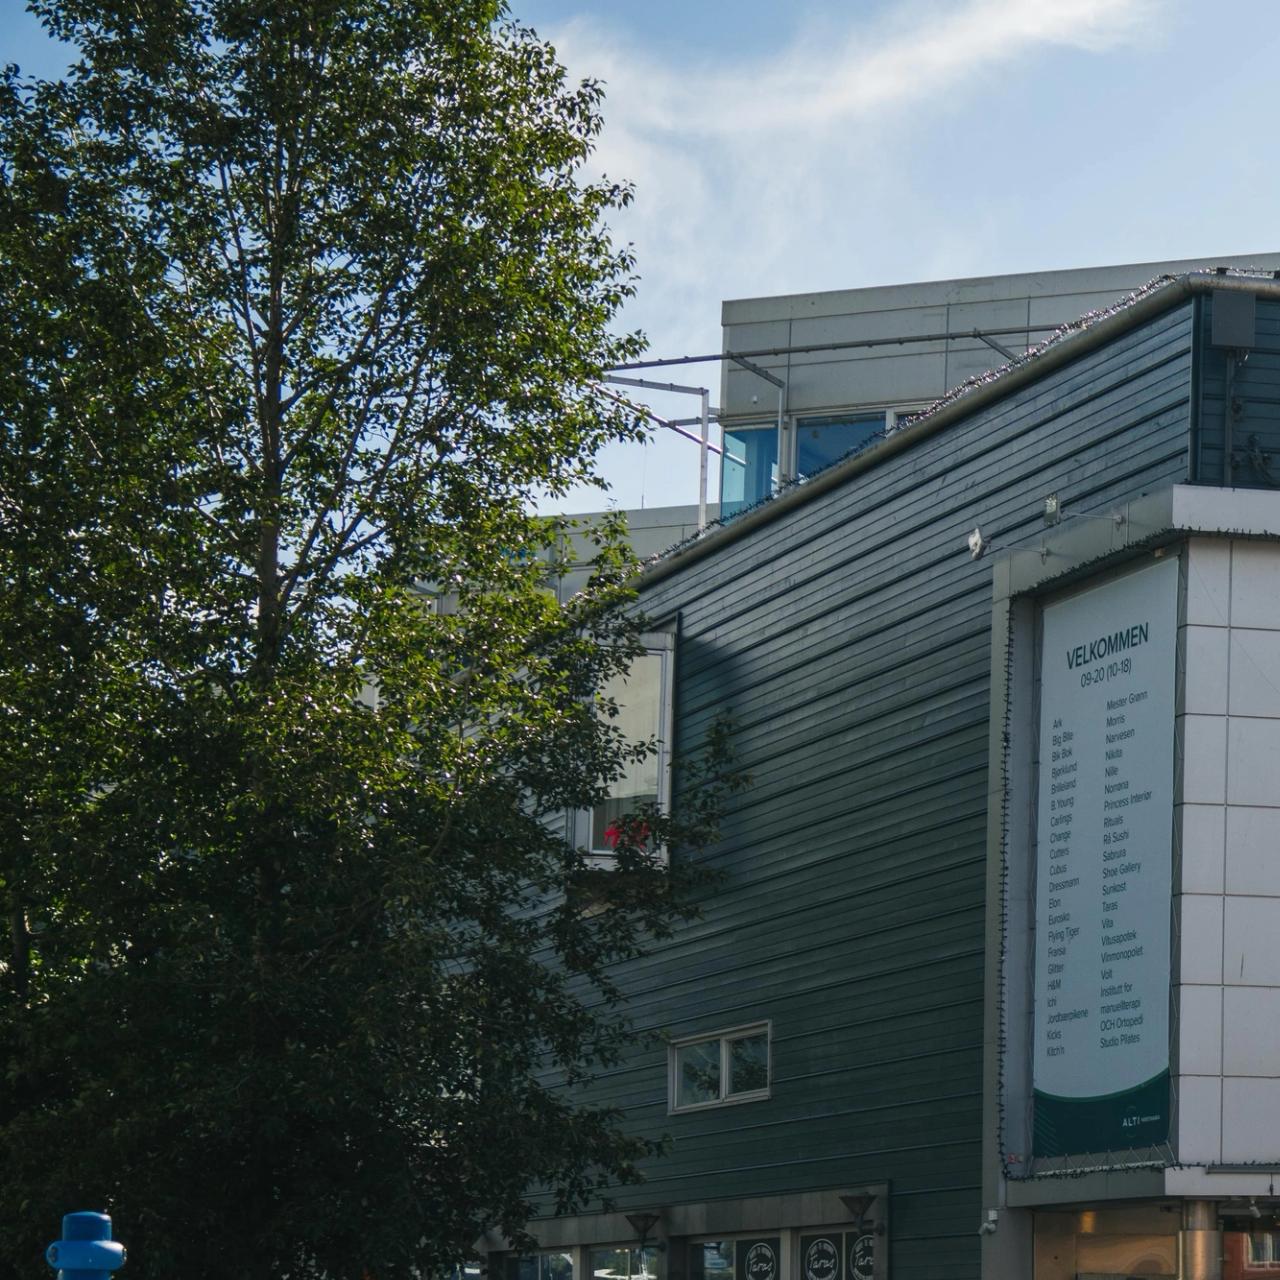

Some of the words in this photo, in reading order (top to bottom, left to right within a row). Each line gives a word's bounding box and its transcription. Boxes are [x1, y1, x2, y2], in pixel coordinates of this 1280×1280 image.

[1066, 622, 1149, 670] VELKOMMEN
[1080, 666, 1105, 688] 09-20
[1107, 658, 1132, 682] (10-18)
[1105, 728, 1135, 744] Narvesen
[1104, 797, 1129, 811] Princess
[1050, 813, 1073, 828] Carlings
[1103, 815, 1124, 828] Rituals
[1050, 830, 1072, 844] Change
[1112, 830, 1129, 843] Sushi
[1049, 847, 1070, 860] Cutters
[1049, 863, 1068, 877] Cubus
[1103, 867, 1119, 880] Shoe
[1119, 862, 1142, 875] Gallery
[1048, 877, 1080, 893] Dressmann
[1102, 881, 1127, 896] Sunkost
[1102, 901, 1119, 912] Taras
[1101, 918, 1115, 929] Vita
[1101, 946, 1144, 963] Vinmonopolet
[1123, 982, 1133, 993] for
[1100, 1036, 1119, 1049] Studio
[1120, 1032, 1141, 1045] Pilates
[1122, 1116, 1141, 1128] ALTI
